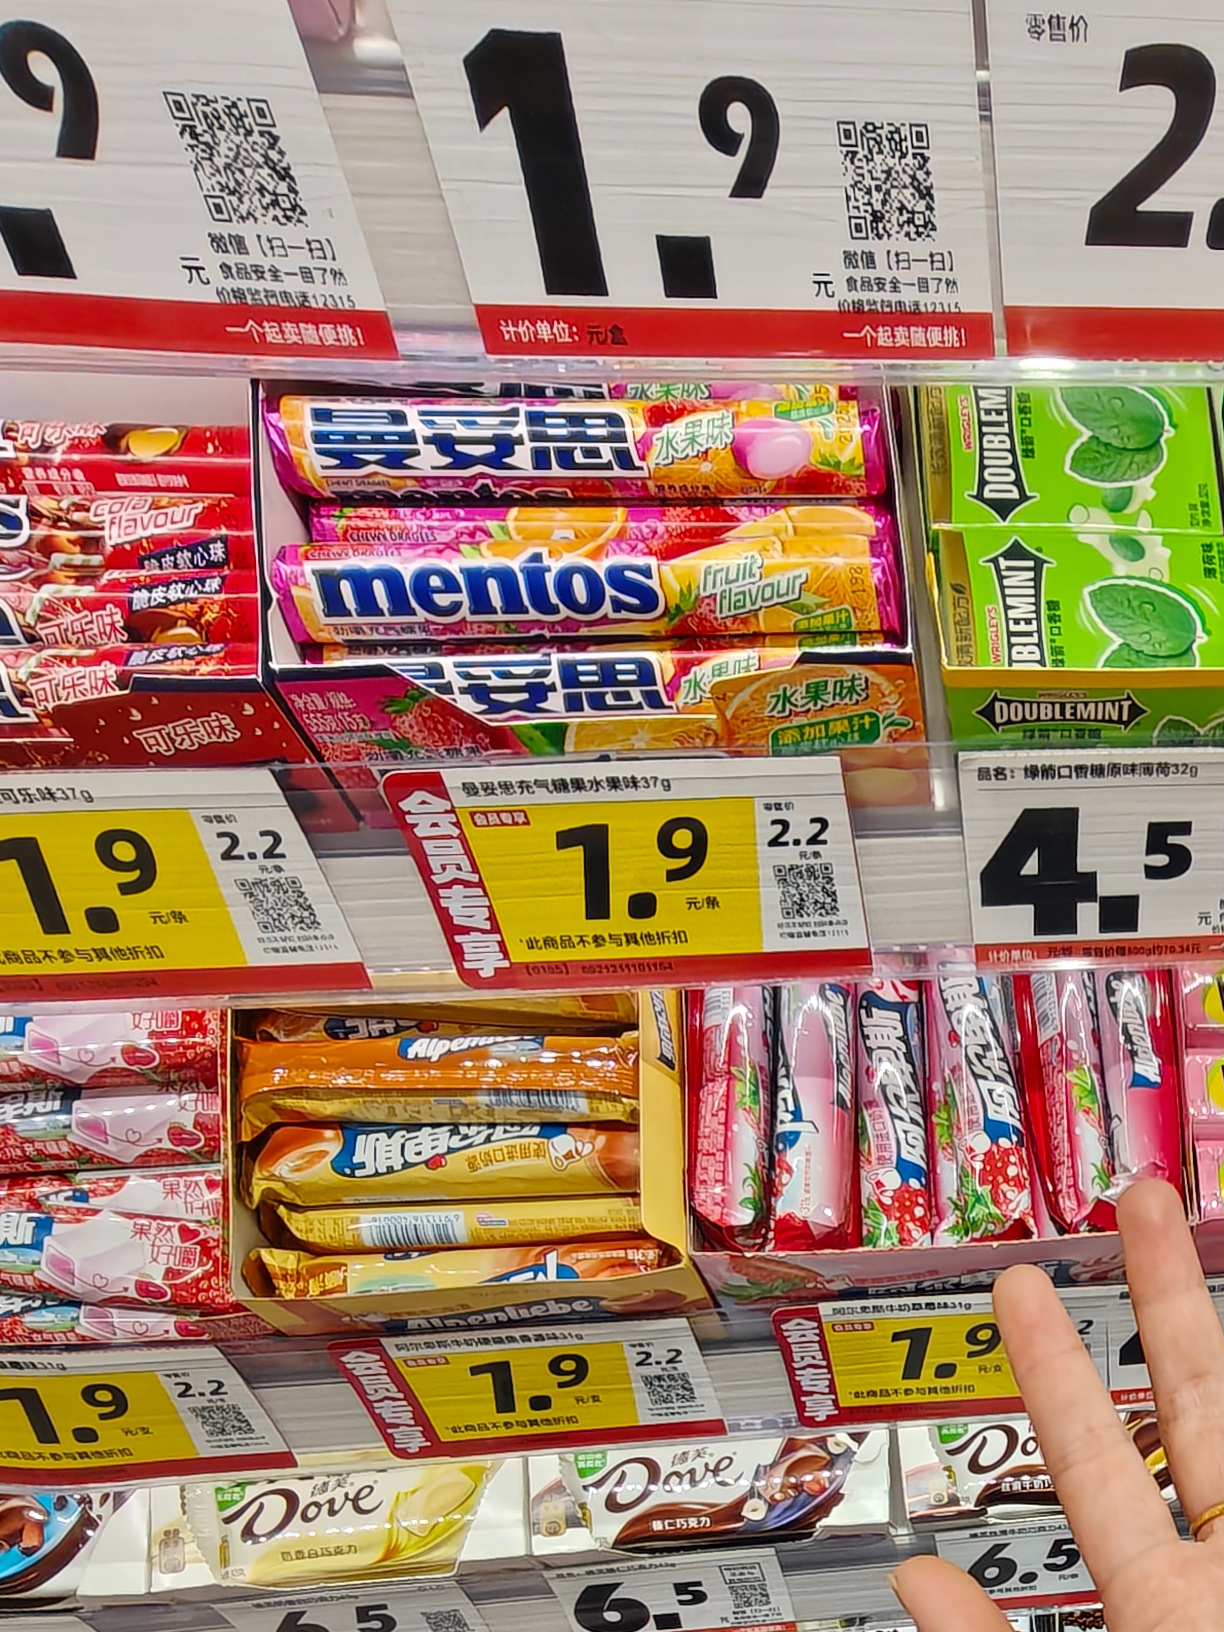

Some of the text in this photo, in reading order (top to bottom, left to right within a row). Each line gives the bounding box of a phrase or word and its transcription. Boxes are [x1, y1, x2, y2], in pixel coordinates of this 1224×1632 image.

[1026, 13, 1089, 43] 零售价
[463, 28, 780, 298] 1.9
[179, 257, 211, 286] 元
[218, 262, 348, 288] 食品安全一目了然
[812, 273, 835, 298] 元
[845, 277, 958, 295] 食品安全一目了然
[310, 404, 645, 471] 曼妥思
[655, 412, 735, 466] 水果味
[105, 503, 203, 545] flavour
[312, 551, 660, 620] mentos
[702, 553, 762, 596] fruit
[716, 571, 808, 621] flavour
[28, 664, 118, 710] 可乐味
[770, 672, 868, 719] 水果味
[134, 712, 240, 755] 可乐味
[993, 700, 1134, 724] DOUBLEMINT
[461, 776, 673, 798] 曼妥思充气糖果水果味37g
[215, 830, 287, 862] 2.2
[767, 816, 830, 849] 2.2
[0, 828, 157, 935] 1.9
[398, 789, 512, 979] 会员专享
[555, 816, 709, 921] 1.9
[980, 806, 1193, 936] 4.5
[1198, 911, 1212, 927] 元
[130, 1221, 176, 1243] 果然
[150, 1244, 200, 1269] 好嚼
[633, 1348, 683, 1368] 2.2
[889, 1322, 1002, 1381] 1.9
[175, 1379, 228, 1399] 2.2
[469, 1352, 590, 1414] 1.9
[581, 1455, 744, 1514] Dove
[221, 1484, 384, 1547] Dove
[966, 1537, 1082, 1588] 6.5
